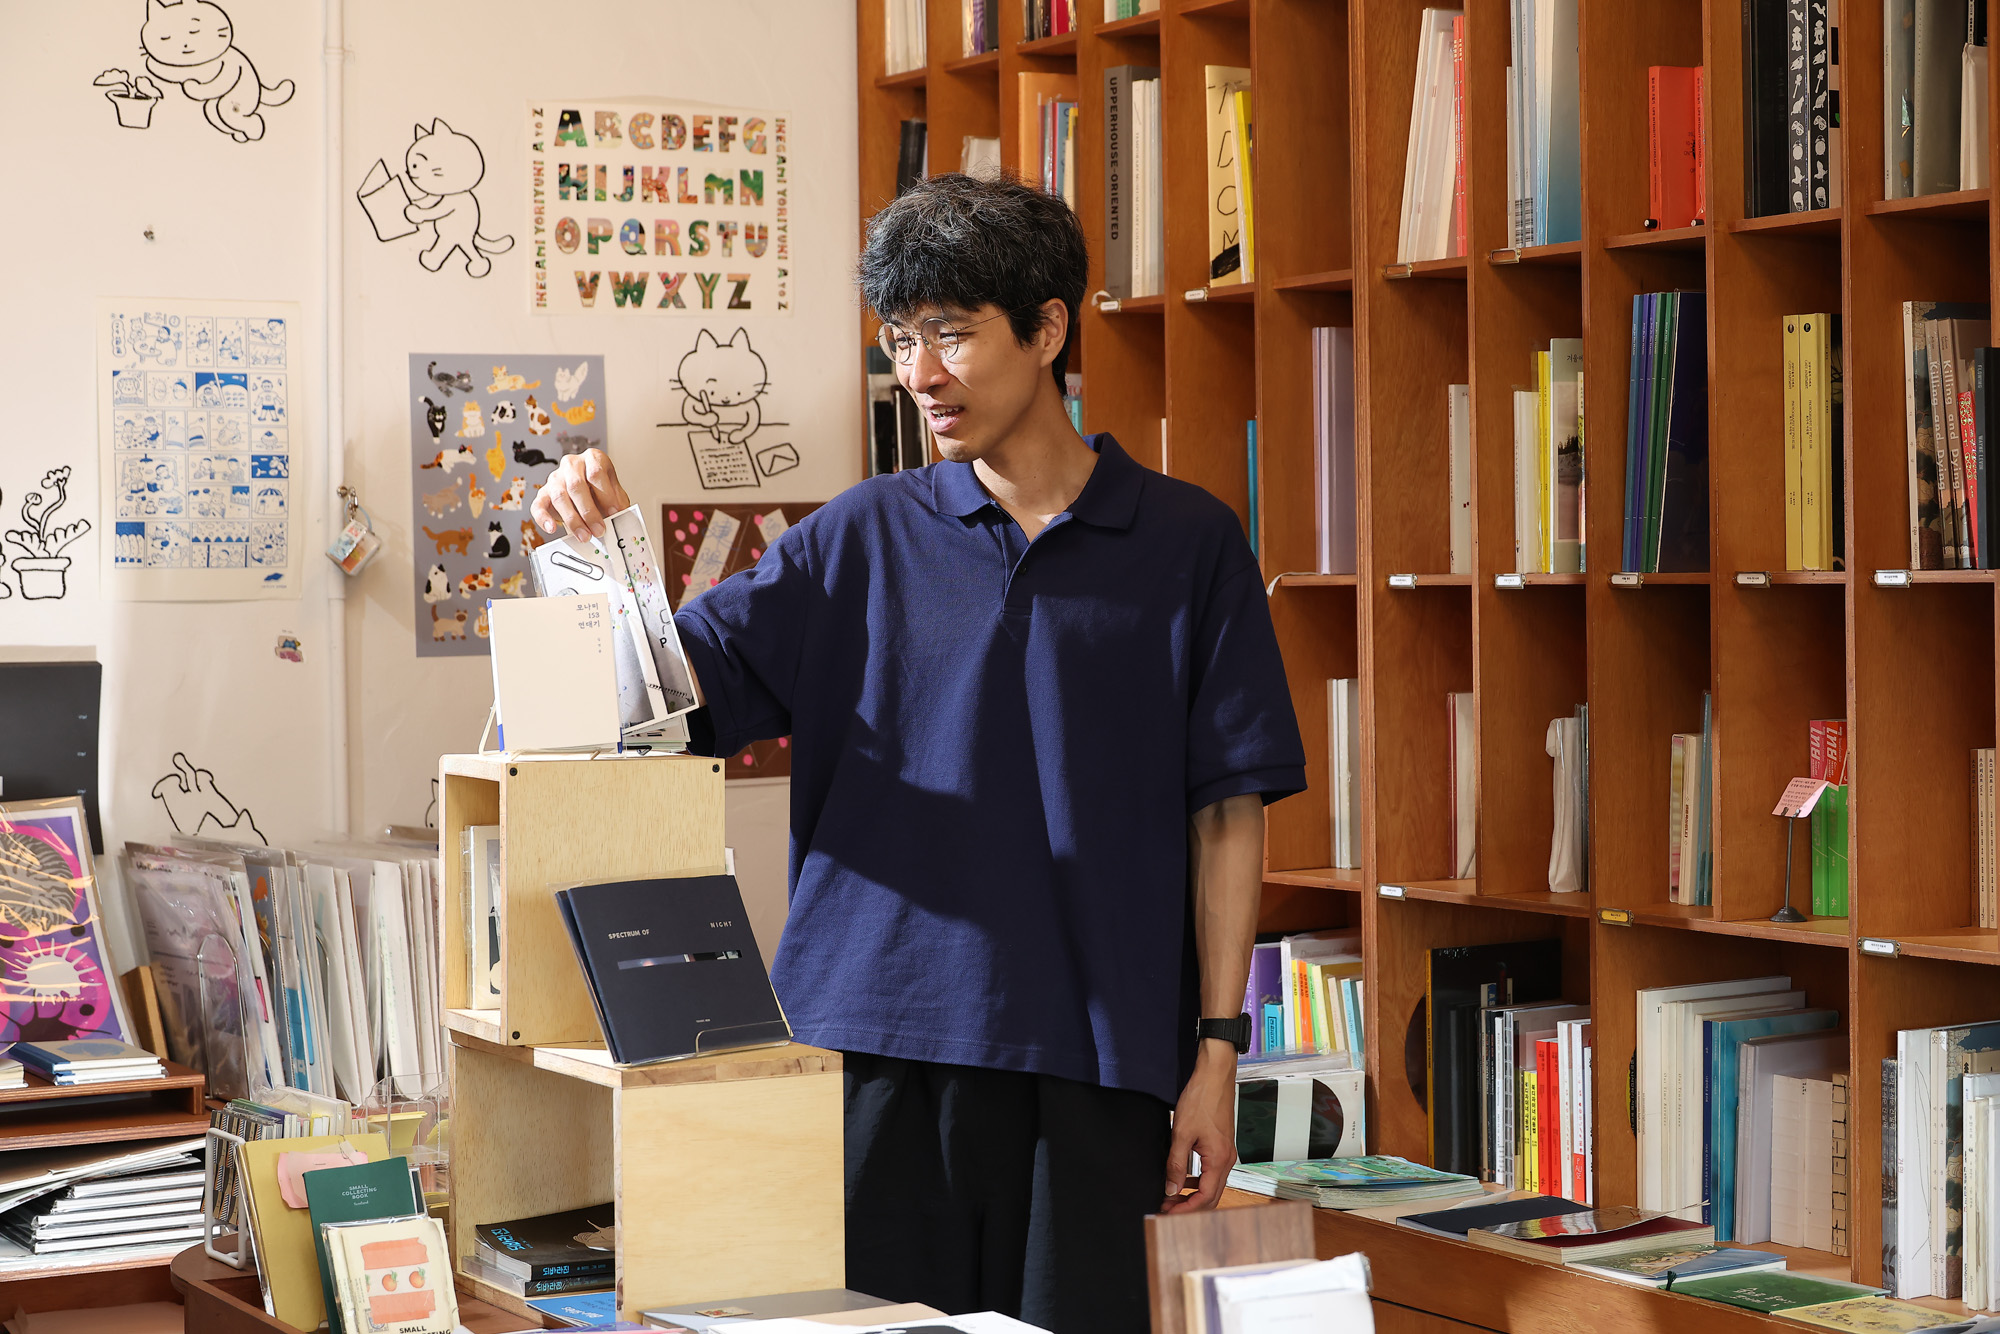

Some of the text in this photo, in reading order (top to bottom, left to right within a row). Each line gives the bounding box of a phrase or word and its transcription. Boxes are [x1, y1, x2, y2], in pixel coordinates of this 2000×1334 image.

[1109, 77, 1120, 241] UPPERHOUSE-ORIENTED
[1929, 361, 1947, 490] Killing and Dying
[1944, 360, 1962, 490] Killing and Dying
[576, 602, 599, 611] 모나미
[578, 620, 601, 629] 연대기
[710, 920, 732, 929] NIGHT
[608, 928, 650, 940] SPECTRUM OF
[341, 1187, 378, 1196] COLLECTING
[399, 1325, 427, 1334] SMALL
